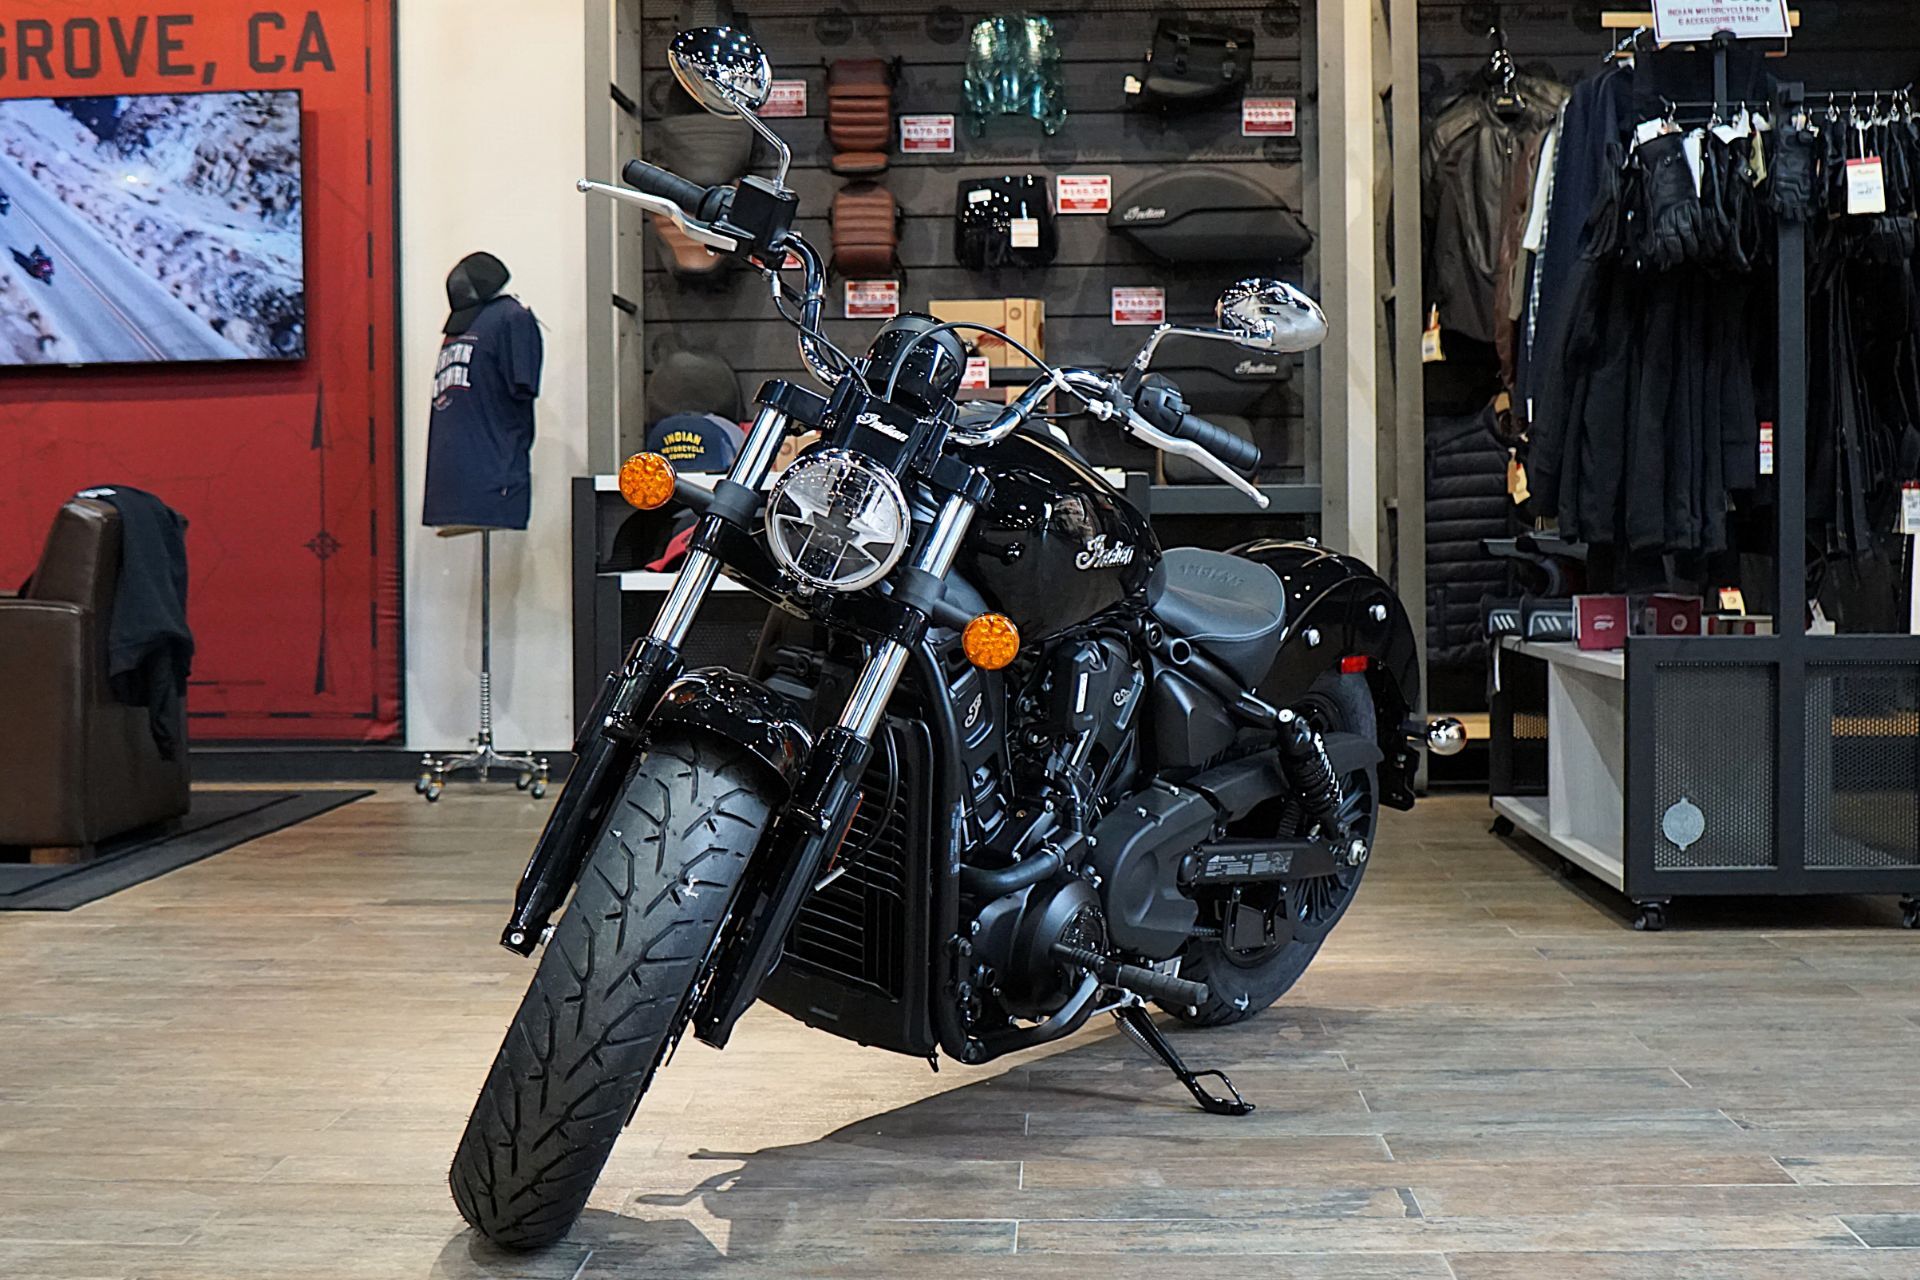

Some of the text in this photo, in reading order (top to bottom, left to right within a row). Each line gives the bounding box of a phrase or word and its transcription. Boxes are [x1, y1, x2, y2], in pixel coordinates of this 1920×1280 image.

[0, 10, 336, 86] ROVE, CA
[663, 431, 702, 446] INDIAN
[855, 412, 909, 442] Indian
[661, 444, 705, 454] MOTORCYCLE
[1075, 534, 1135, 570] Indian
